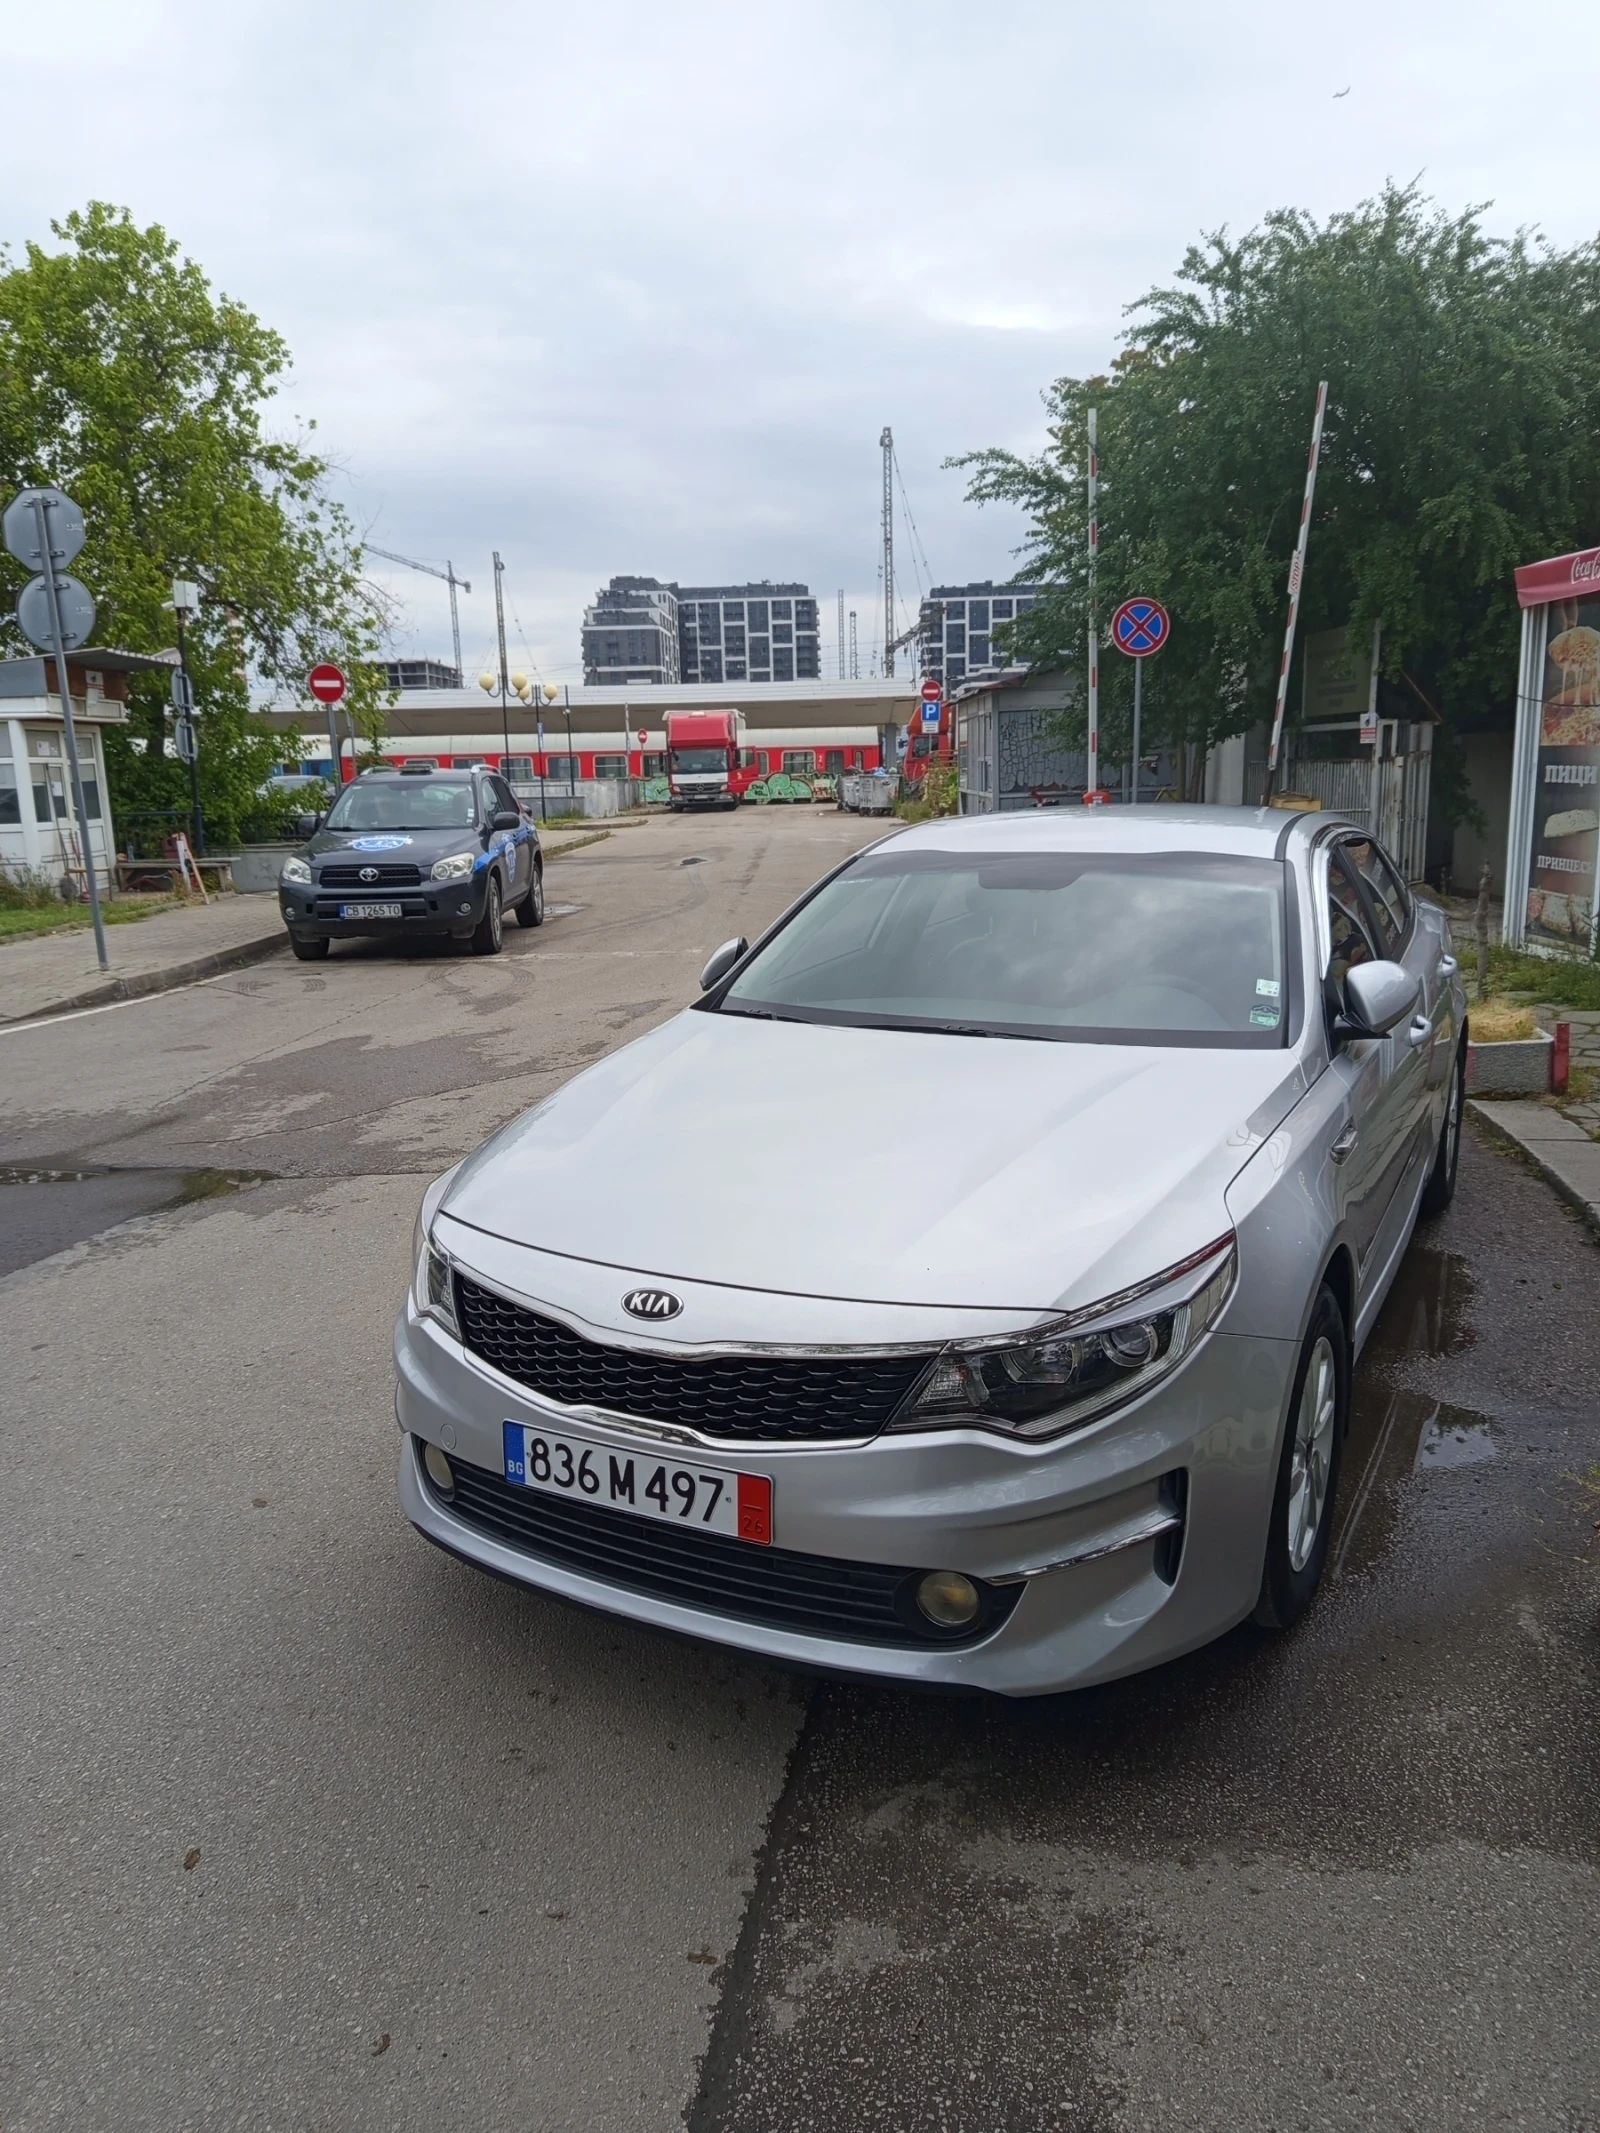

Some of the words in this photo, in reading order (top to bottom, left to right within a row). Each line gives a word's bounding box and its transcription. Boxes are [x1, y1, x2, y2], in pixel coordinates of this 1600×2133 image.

[1291, 560, 1300, 590] STOP
[926, 704, 937, 719] P
[1544, 764, 1598, 787] ПИЦИ
[345, 906, 359, 916] CB
[362, 905, 386, 916] 1265
[629, 1292, 670, 1315] KIA
[507, 1460, 524, 1476] BG
[530, 1437, 600, 1495] 836
[609, 1455, 635, 1505] M
[645, 1466, 724, 1522] 497
[743, 1515, 763, 1535] 26
